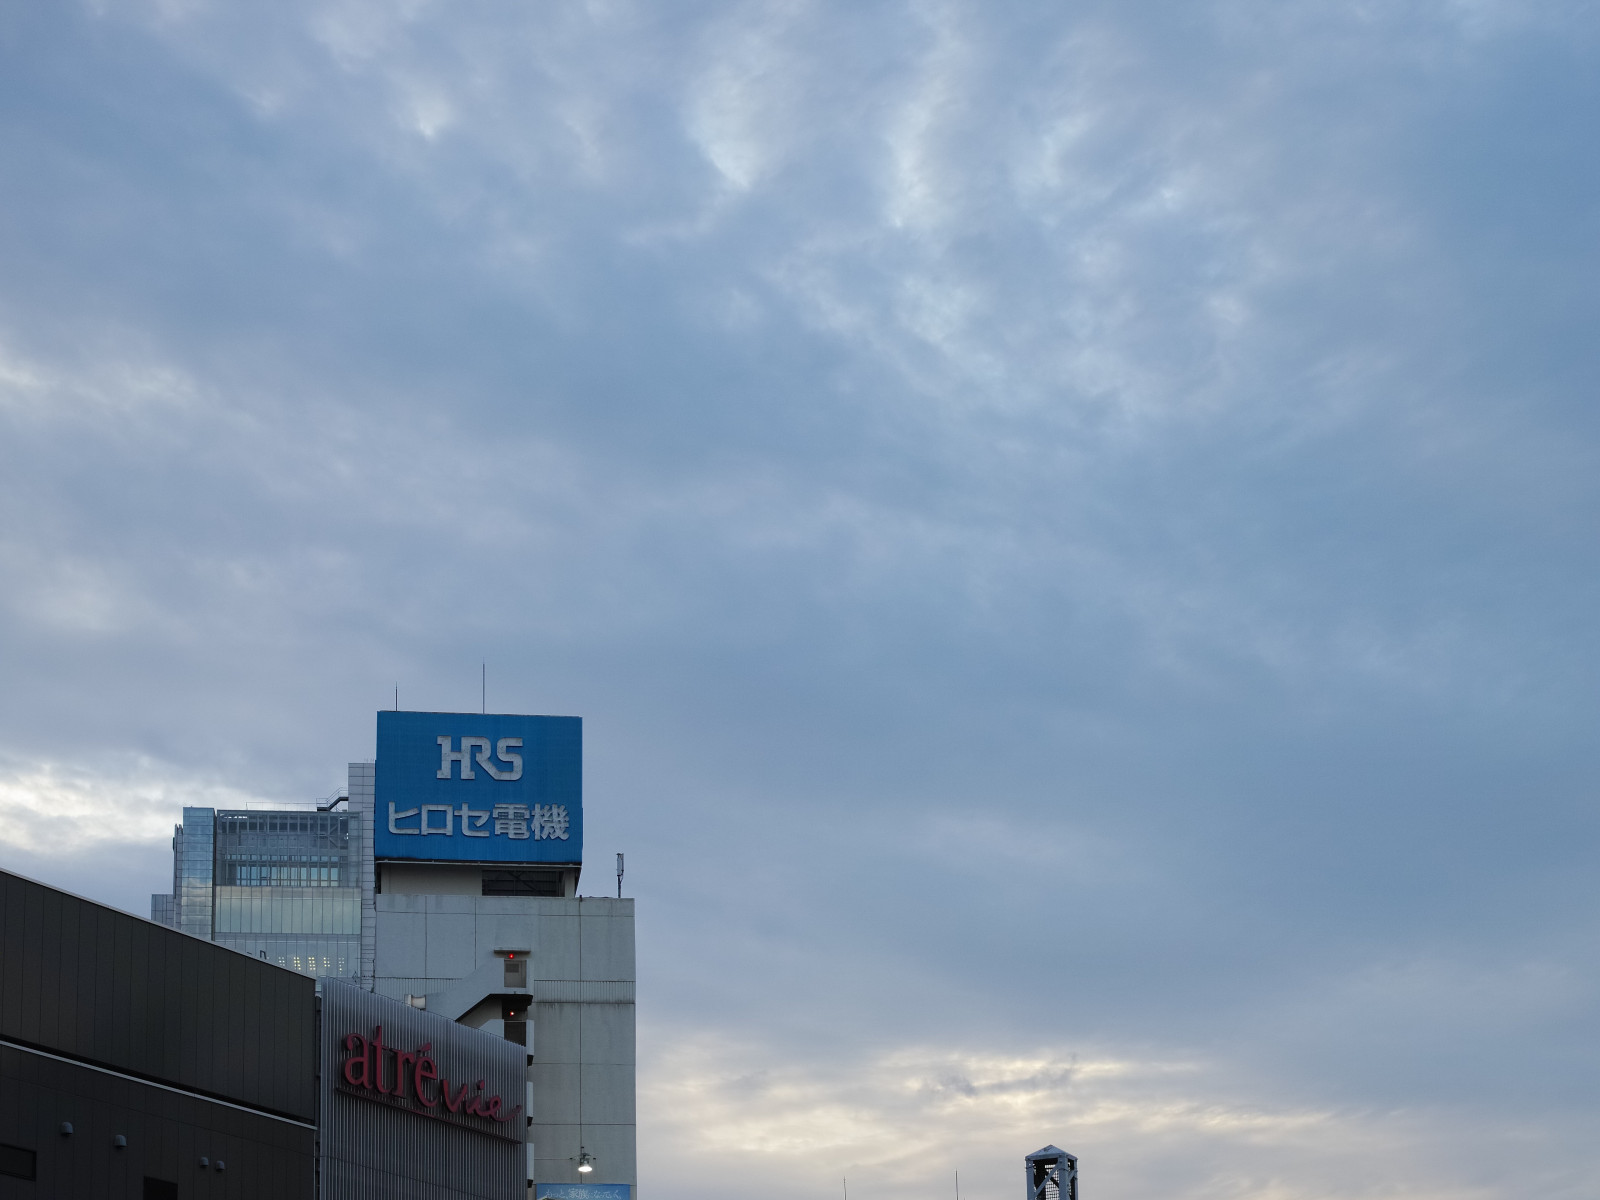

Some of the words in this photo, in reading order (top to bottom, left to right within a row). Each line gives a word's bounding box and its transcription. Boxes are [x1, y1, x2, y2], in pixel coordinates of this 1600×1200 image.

[436, 735, 523, 781] HRS
[388, 801, 570, 841] ヒロセ電機
[344, 1025, 438, 1108] atré
[440, 1079, 522, 1122] vie
